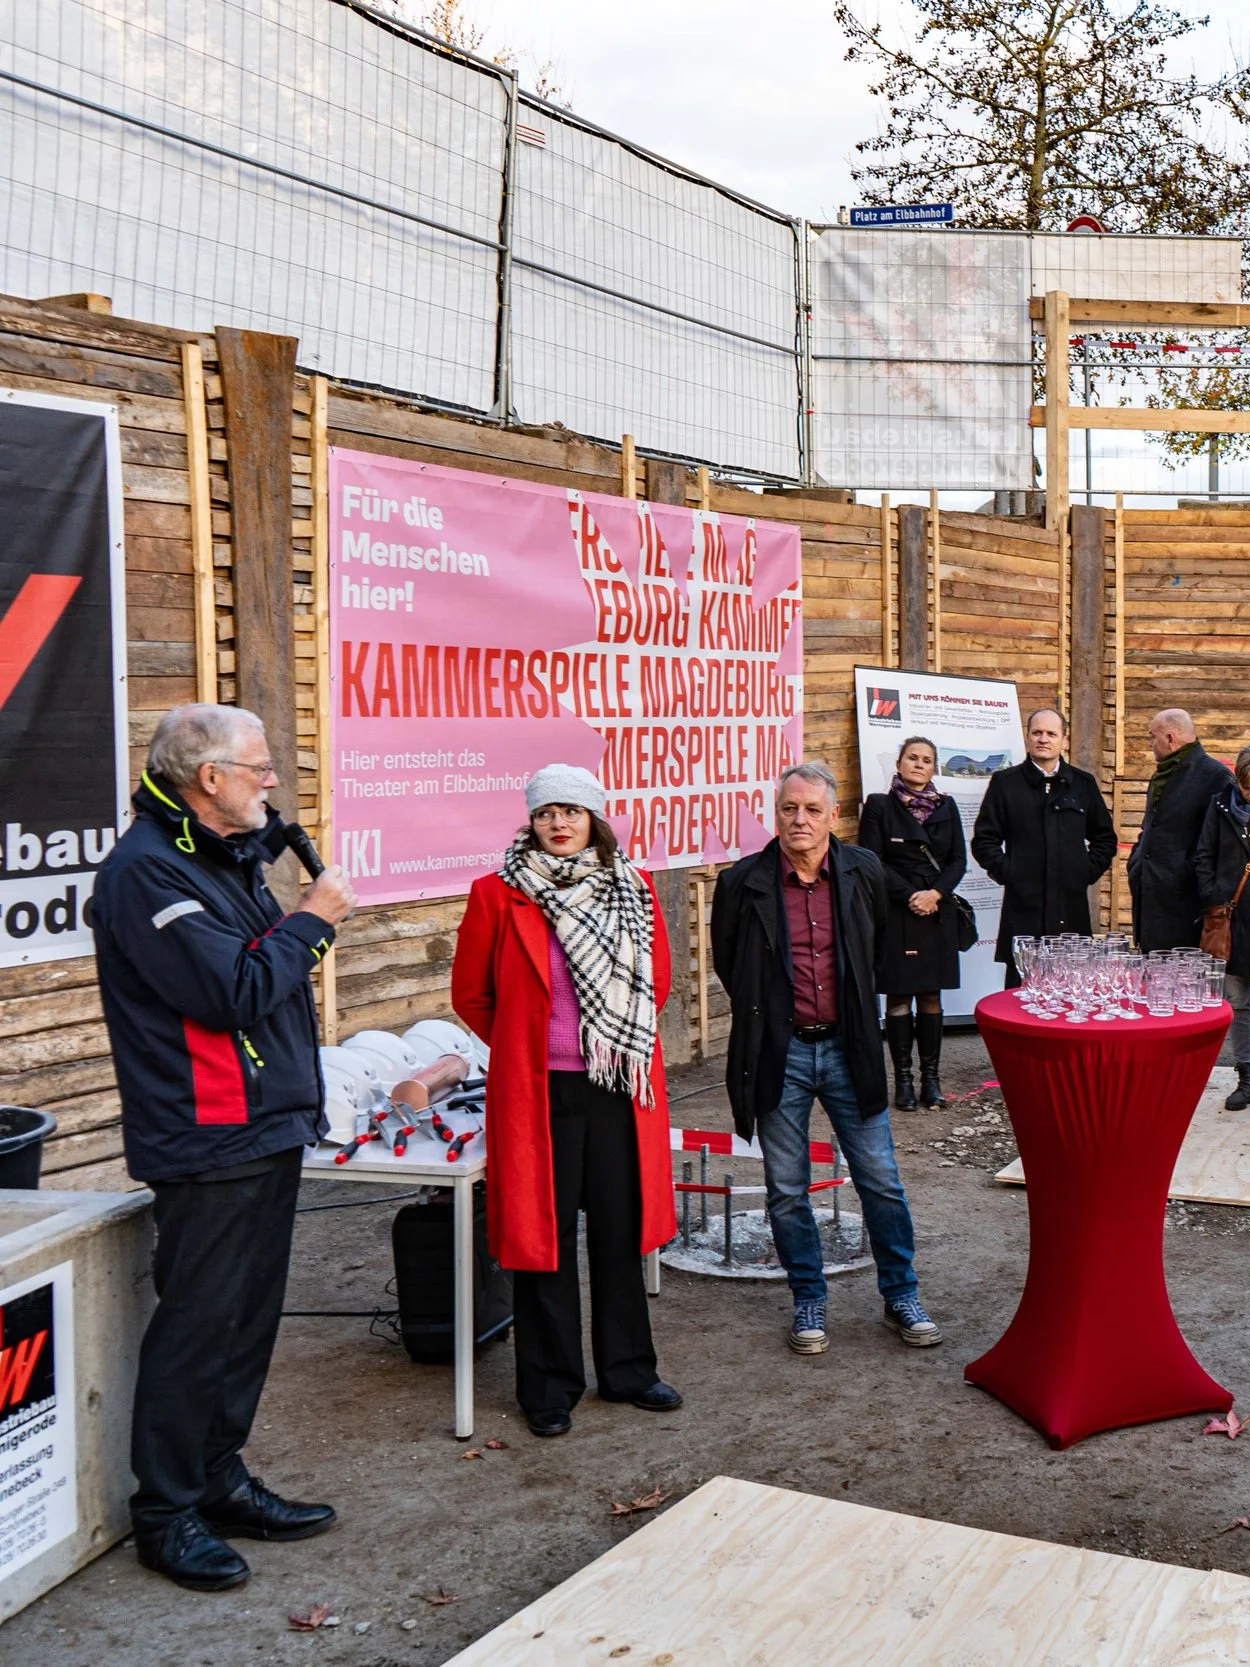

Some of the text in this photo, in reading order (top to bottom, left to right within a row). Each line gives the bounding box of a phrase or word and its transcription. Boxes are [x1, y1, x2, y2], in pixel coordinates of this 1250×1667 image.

[855, 207, 946, 222] Platz am Elbbahnhof
[342, 484, 444, 530] Für die
[341, 529, 490, 577] Menschen
[341, 574, 414, 612] hier!
[583, 577, 690, 648] EBURG
[341, 640, 794, 718] KAMMERSPIELE MAGDEBURG
[924, 694, 939, 702] UNS
[940, 695, 971, 705] KÖNNEN
[985, 700, 1009, 708] BAUEN
[340, 748, 486, 771] Hier entsteht das
[593, 725, 748, 791] MERSPIELE
[340, 772, 531, 799] Theater am Elbbahnhof
[0, 823, 116, 871] bau
